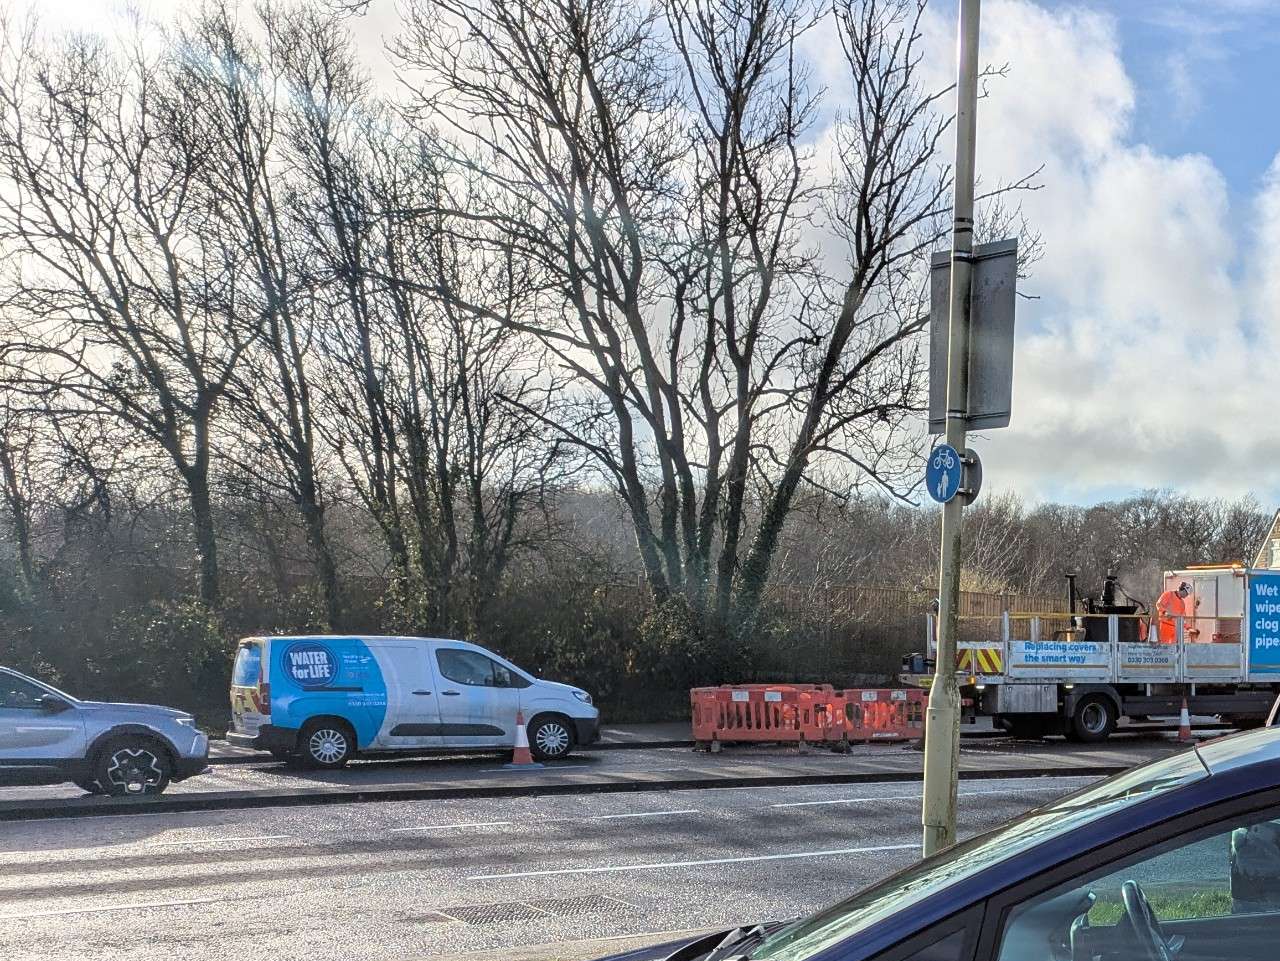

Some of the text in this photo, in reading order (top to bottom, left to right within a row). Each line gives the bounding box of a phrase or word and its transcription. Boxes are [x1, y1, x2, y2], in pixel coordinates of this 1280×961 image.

[1255, 584, 1279, 596] Wet
[1255, 618, 1279, 632] clog
[1024, 642, 1097, 654] Replacing covers
[289, 651, 328, 665] WATER
[1024, 654, 1086, 664] the smart way
